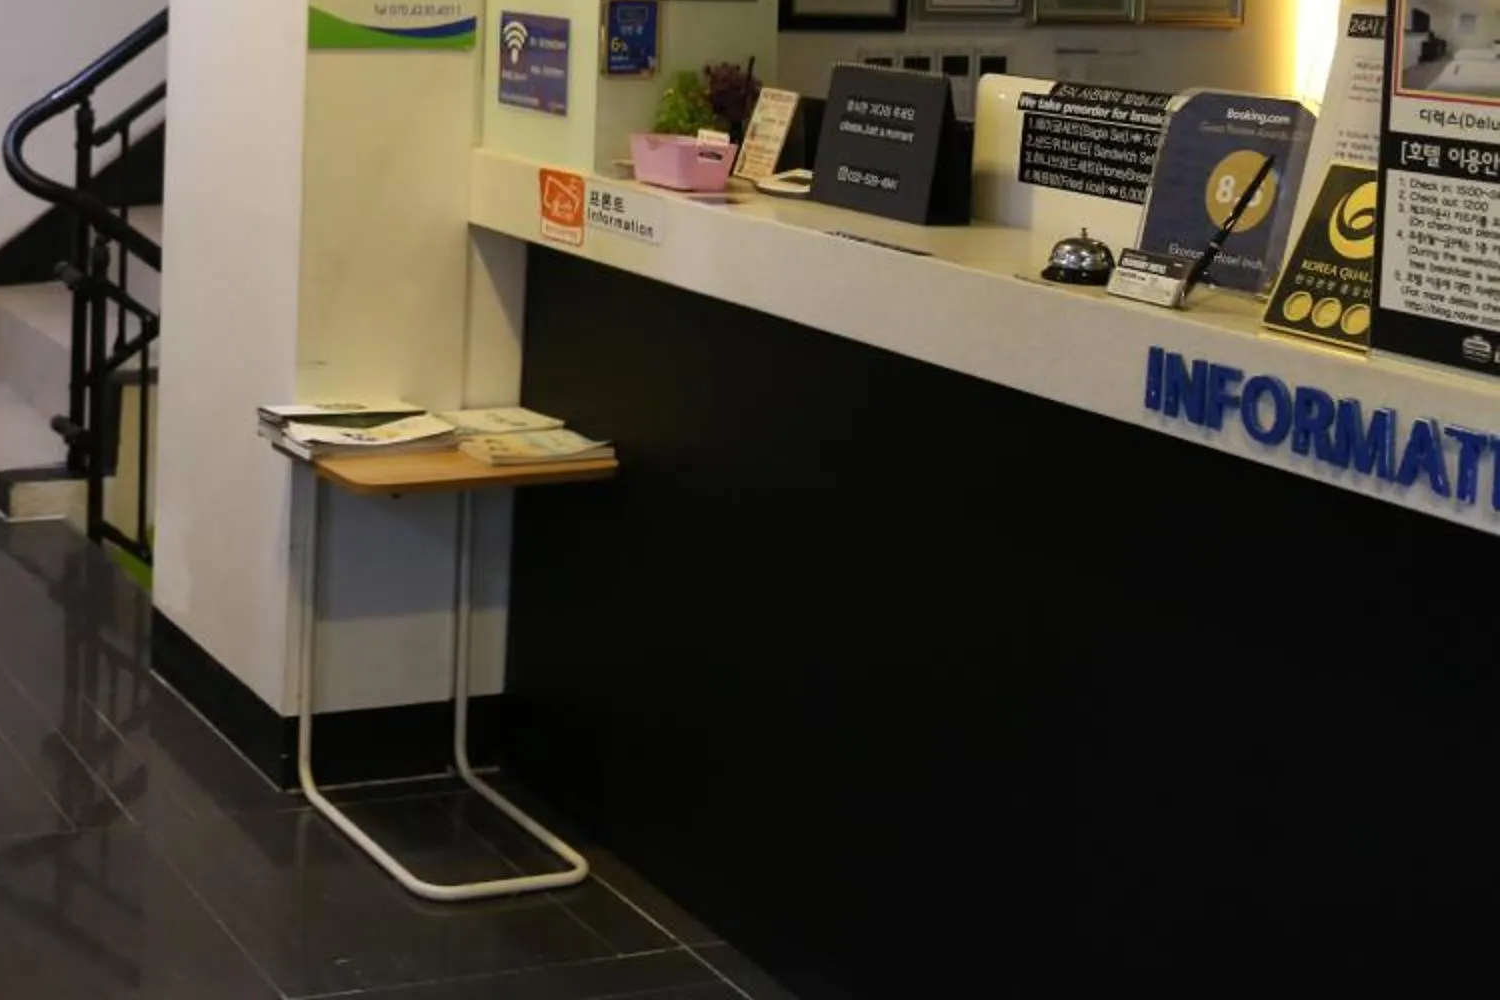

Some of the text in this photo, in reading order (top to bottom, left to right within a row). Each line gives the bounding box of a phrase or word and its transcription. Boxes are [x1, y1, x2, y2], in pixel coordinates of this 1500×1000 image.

[1226, 107, 1291, 126] Booking.com
[1401, 141, 1441, 168] [호텔
[1410, 177, 1438, 191] Check
[589, 190, 626, 213] 프론트
[1409, 191, 1438, 204] Check
[587, 207, 654, 238] Information
[1301, 259, 1338, 277] KOREA
